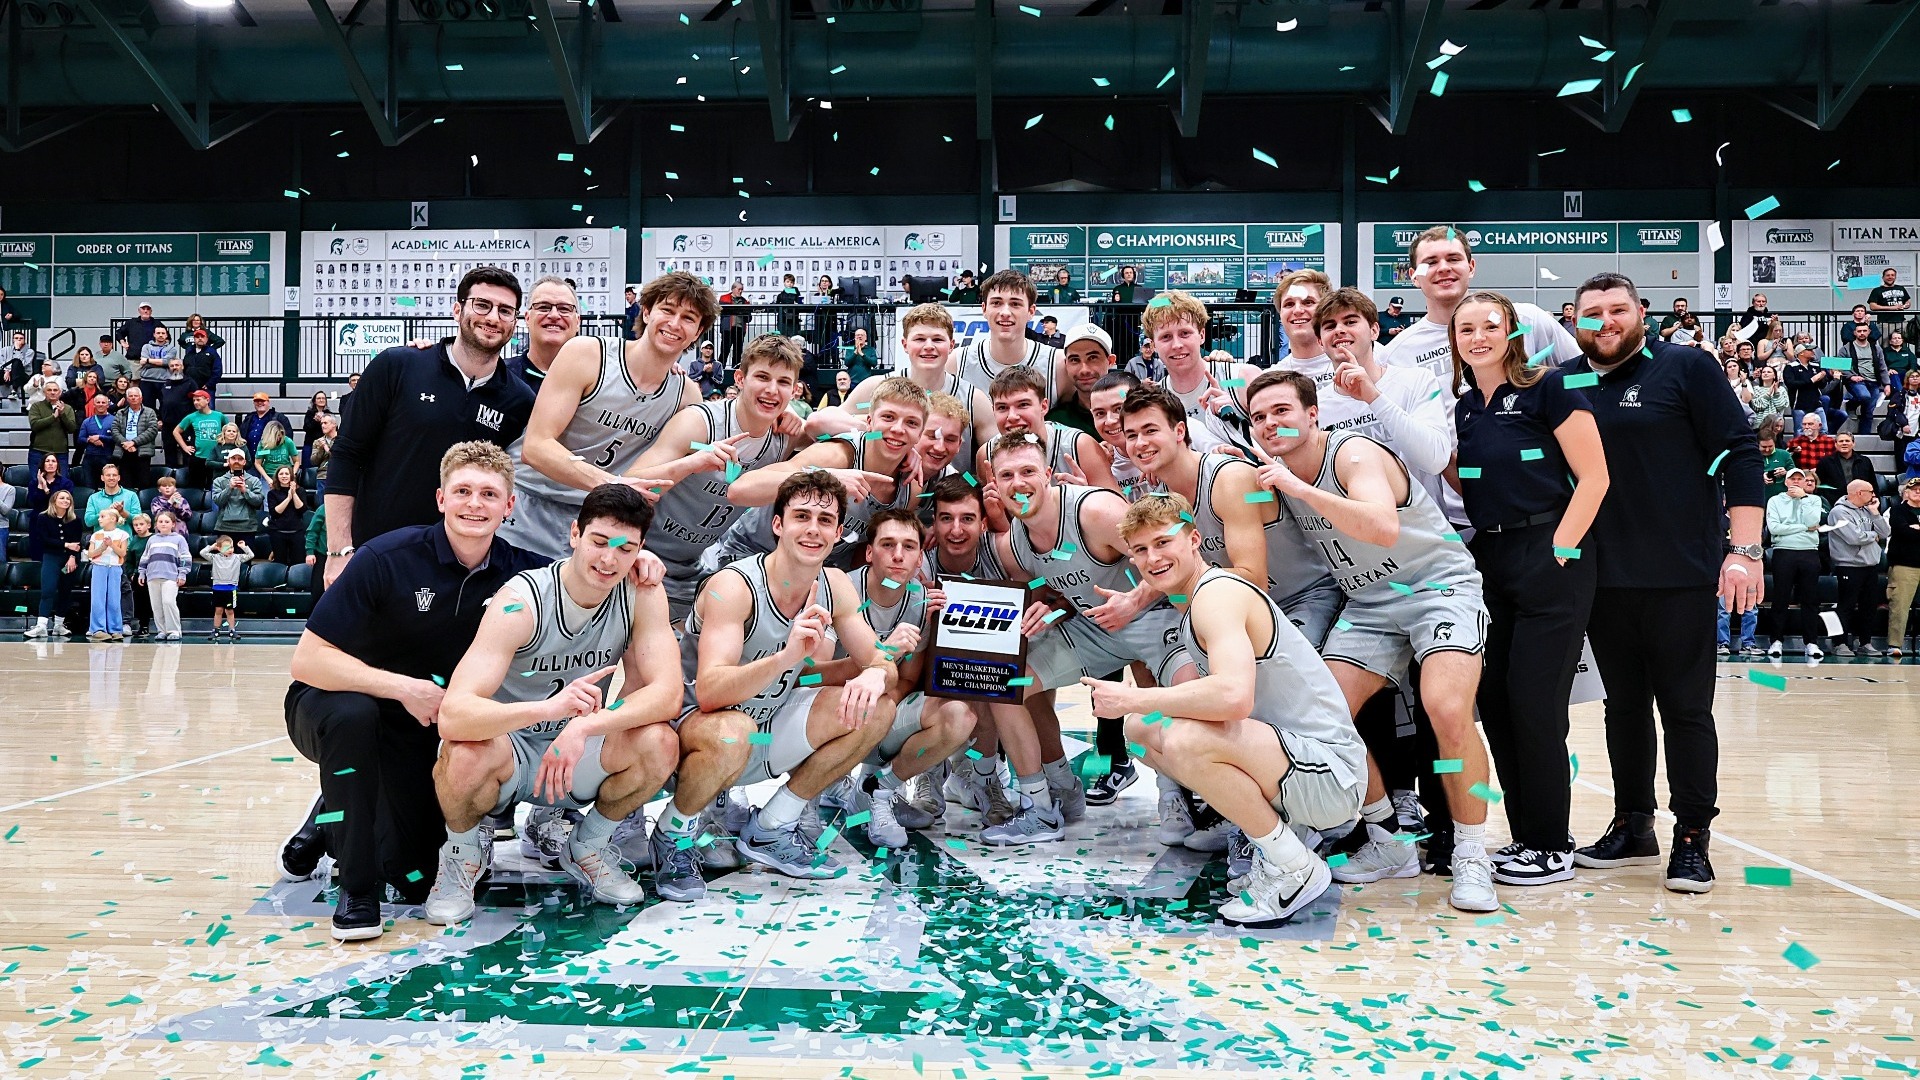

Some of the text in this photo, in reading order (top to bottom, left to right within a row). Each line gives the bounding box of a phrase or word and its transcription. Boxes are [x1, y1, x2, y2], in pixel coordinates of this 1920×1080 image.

[1002, 199, 1013, 217] L
[1565, 195, 1581, 213] M
[413, 205, 426, 222] K
[1030, 234, 1068, 244] TITANS
[1267, 232, 1306, 242] TITANS
[1484, 231, 1608, 245] CHAMPIONSHIPS
[1639, 229, 1680, 240] TITANS
[1779, 233, 1813, 242] TITANS
[1838, 227, 1883, 239] TITAN
[217, 240, 252, 250] TITANS
[453, 239, 531, 250] ALL-AMERICA
[736, 236, 881, 247] ACADEMIC ALL-AMERICA
[1116, 234, 1236, 247] CHAMPIONSHIPS
[77, 243, 173, 254] ORDER OF TITANS
[362, 324, 401, 333] STUDENT
[364, 335, 400, 344] SECTION
[478, 403, 505, 425] IWU
[596, 408, 658, 441] ILLINOIS
[1332, 419, 1353, 430] NOIS
[594, 437, 625, 469] 5
[702, 479, 728, 497] ILL
[697, 503, 735, 529] 13
[1316, 538, 1358, 571] 14
[941, 603, 1021, 632] CCIW
[530, 648, 612, 672] ILLINOIS
[942, 661, 1010, 675] MEN'S BASKETBALL
[951, 671, 1000, 683] TOURNAMENT
[942, 679, 956, 687] 2026
[964, 682, 1007, 692] CHAMPIONS
